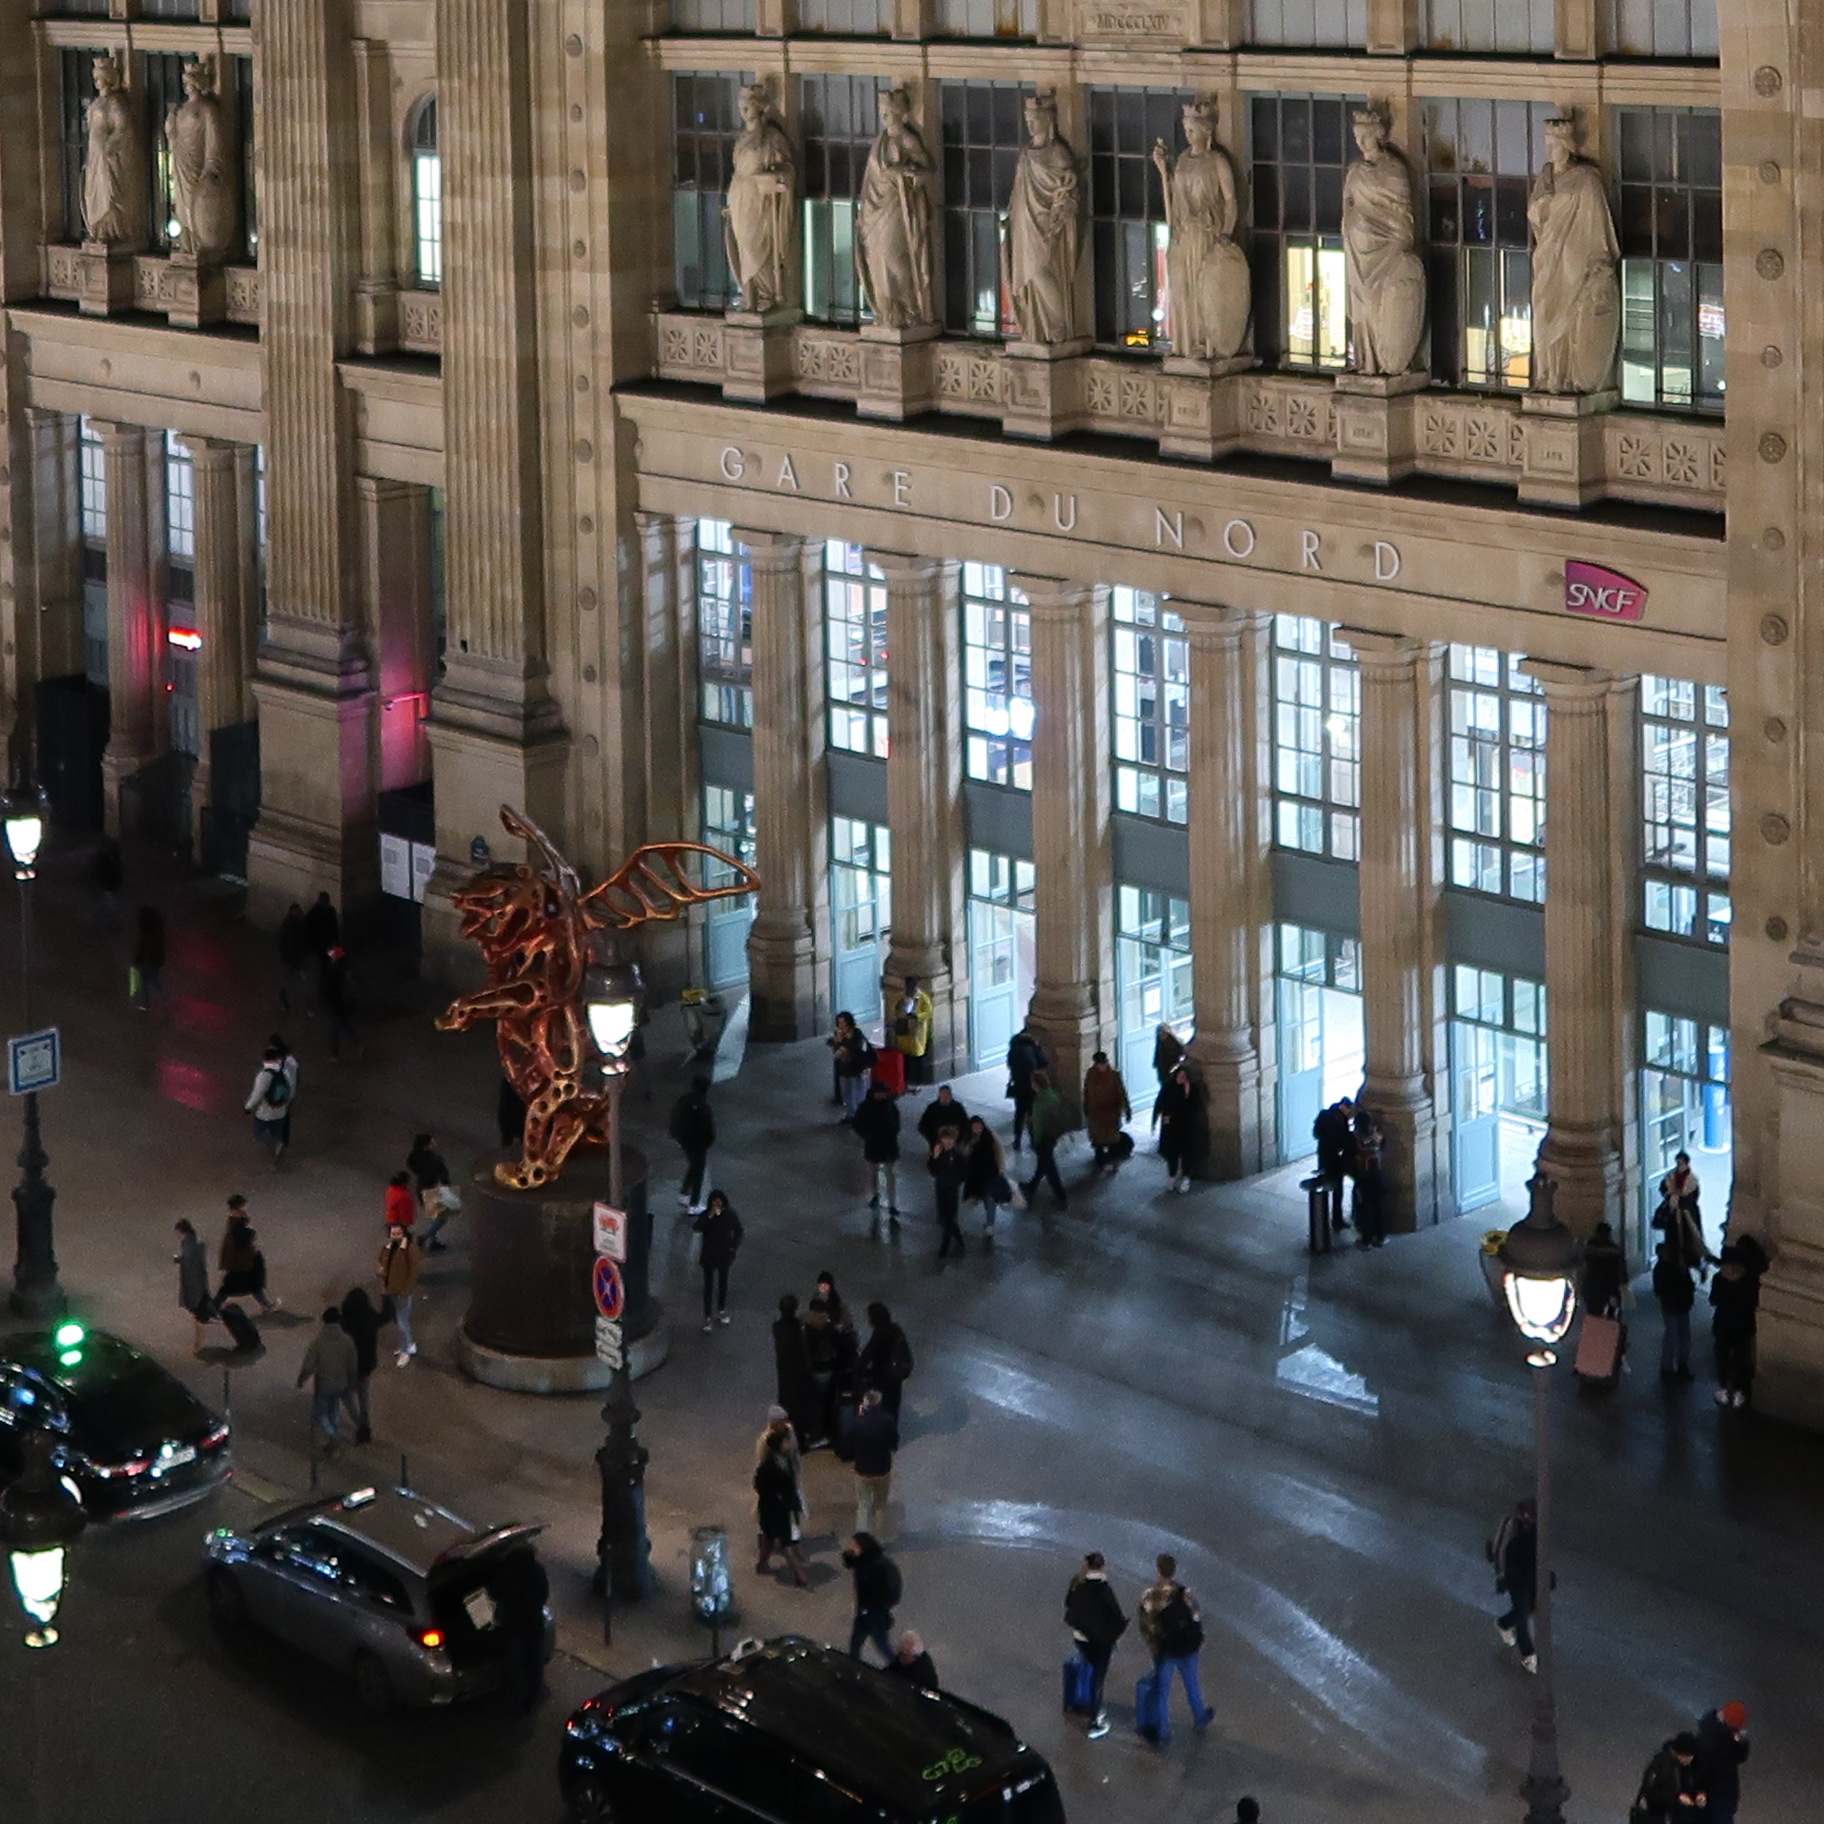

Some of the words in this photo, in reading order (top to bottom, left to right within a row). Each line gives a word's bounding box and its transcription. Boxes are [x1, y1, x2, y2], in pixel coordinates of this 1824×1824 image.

[721, 447, 913, 505] GARE
[992, 486, 1077, 530] DU
[1155, 507, 1401, 580] NORD
[1568, 583, 1638, 613] SNCF
